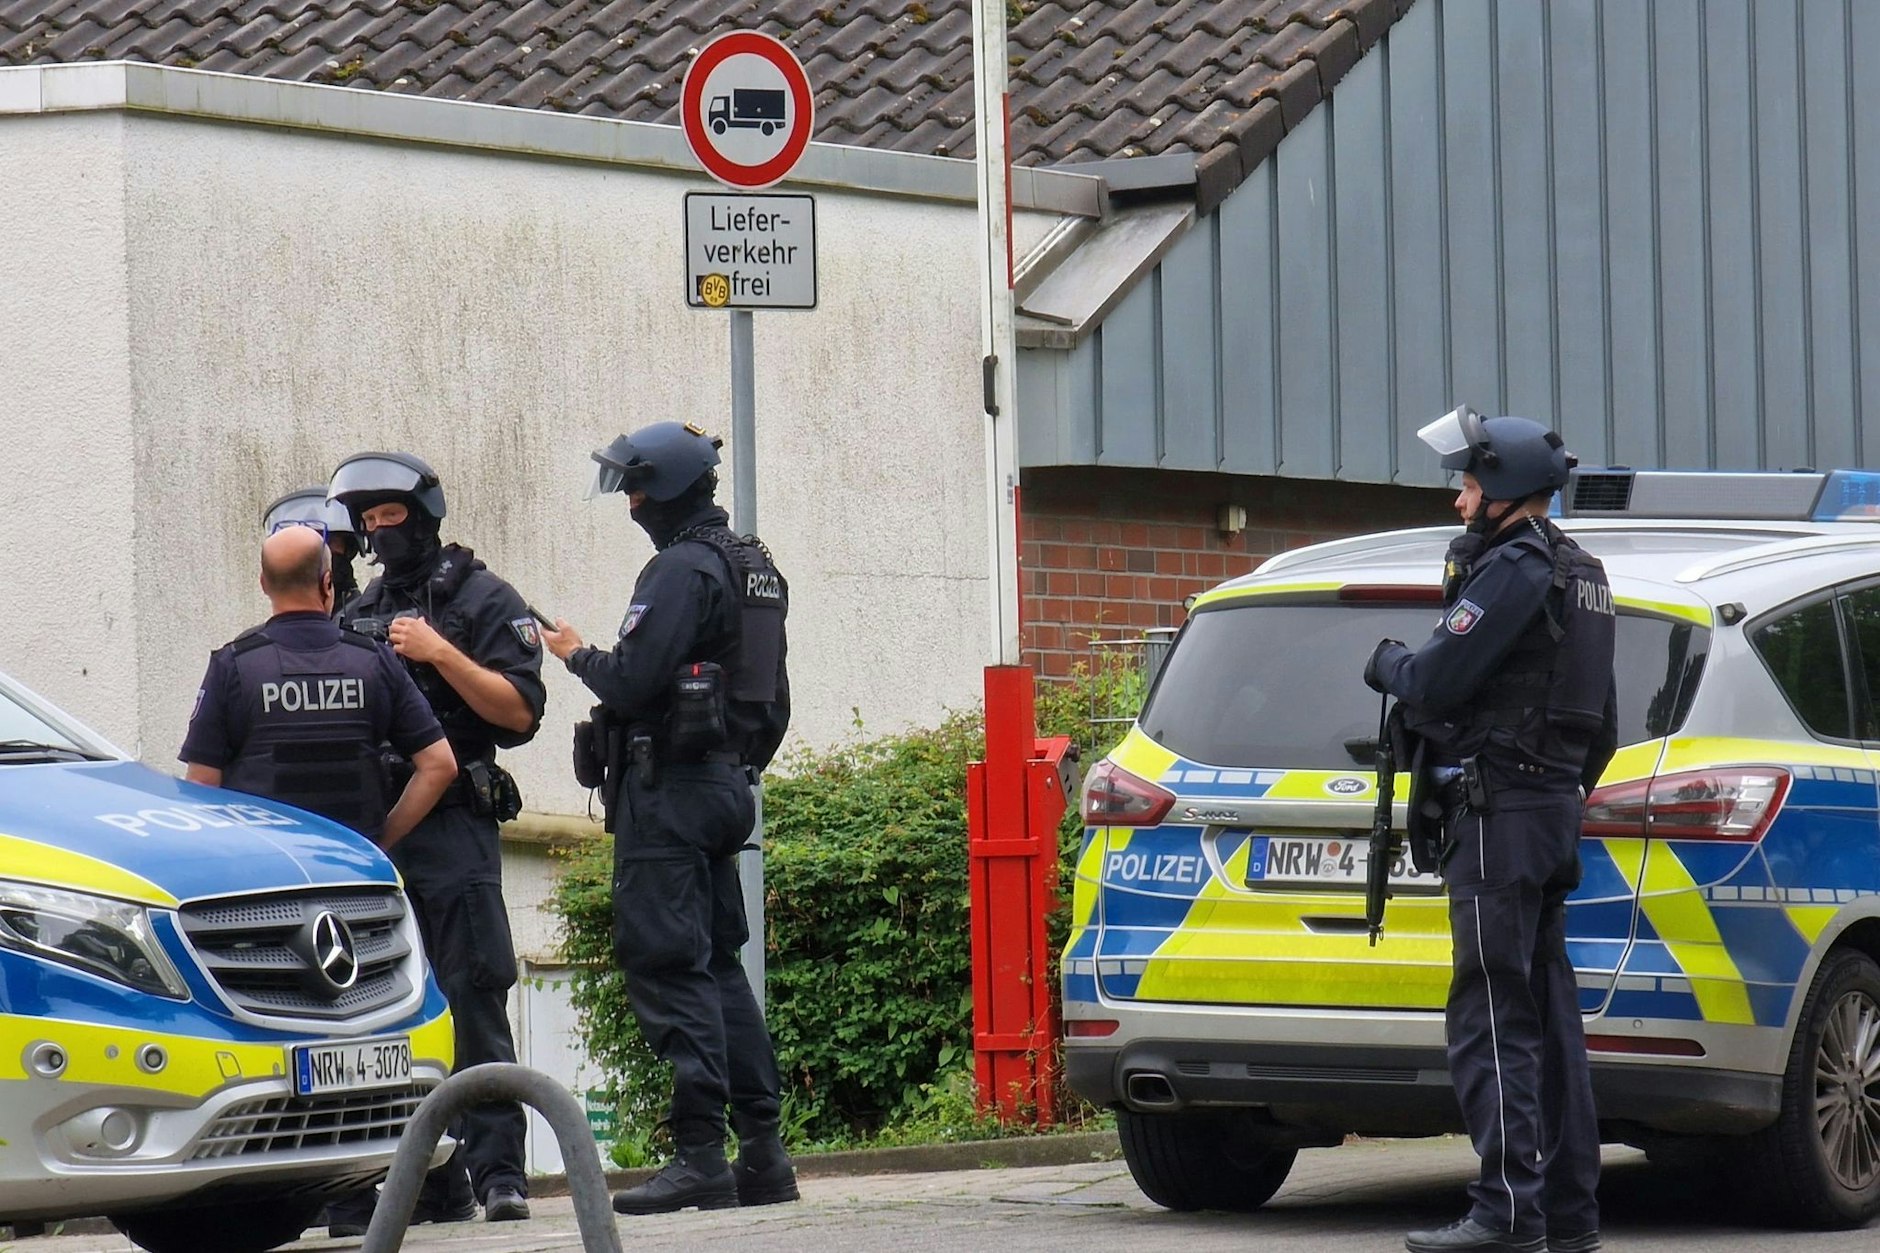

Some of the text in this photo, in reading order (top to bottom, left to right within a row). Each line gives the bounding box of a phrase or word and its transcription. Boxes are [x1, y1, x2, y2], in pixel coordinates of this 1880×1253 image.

[711, 205, 791, 232] Liefer-
[704, 238, 798, 264] verkehr
[705, 277, 726, 299] BVB
[732, 271, 770, 296] frei
[1577, 578, 1616, 617] POLIZE
[262, 679, 365, 712] POLIZEI
[1333, 779, 1360, 793] Ford
[94, 803, 303, 837] POLIZEI
[1105, 853, 1204, 884] POLIZEI
[1253, 862, 1261, 873] D
[1266, 841, 1324, 876] NRW
[310, 1050, 345, 1087] NRW
[356, 1043, 410, 1082] 4-3078
